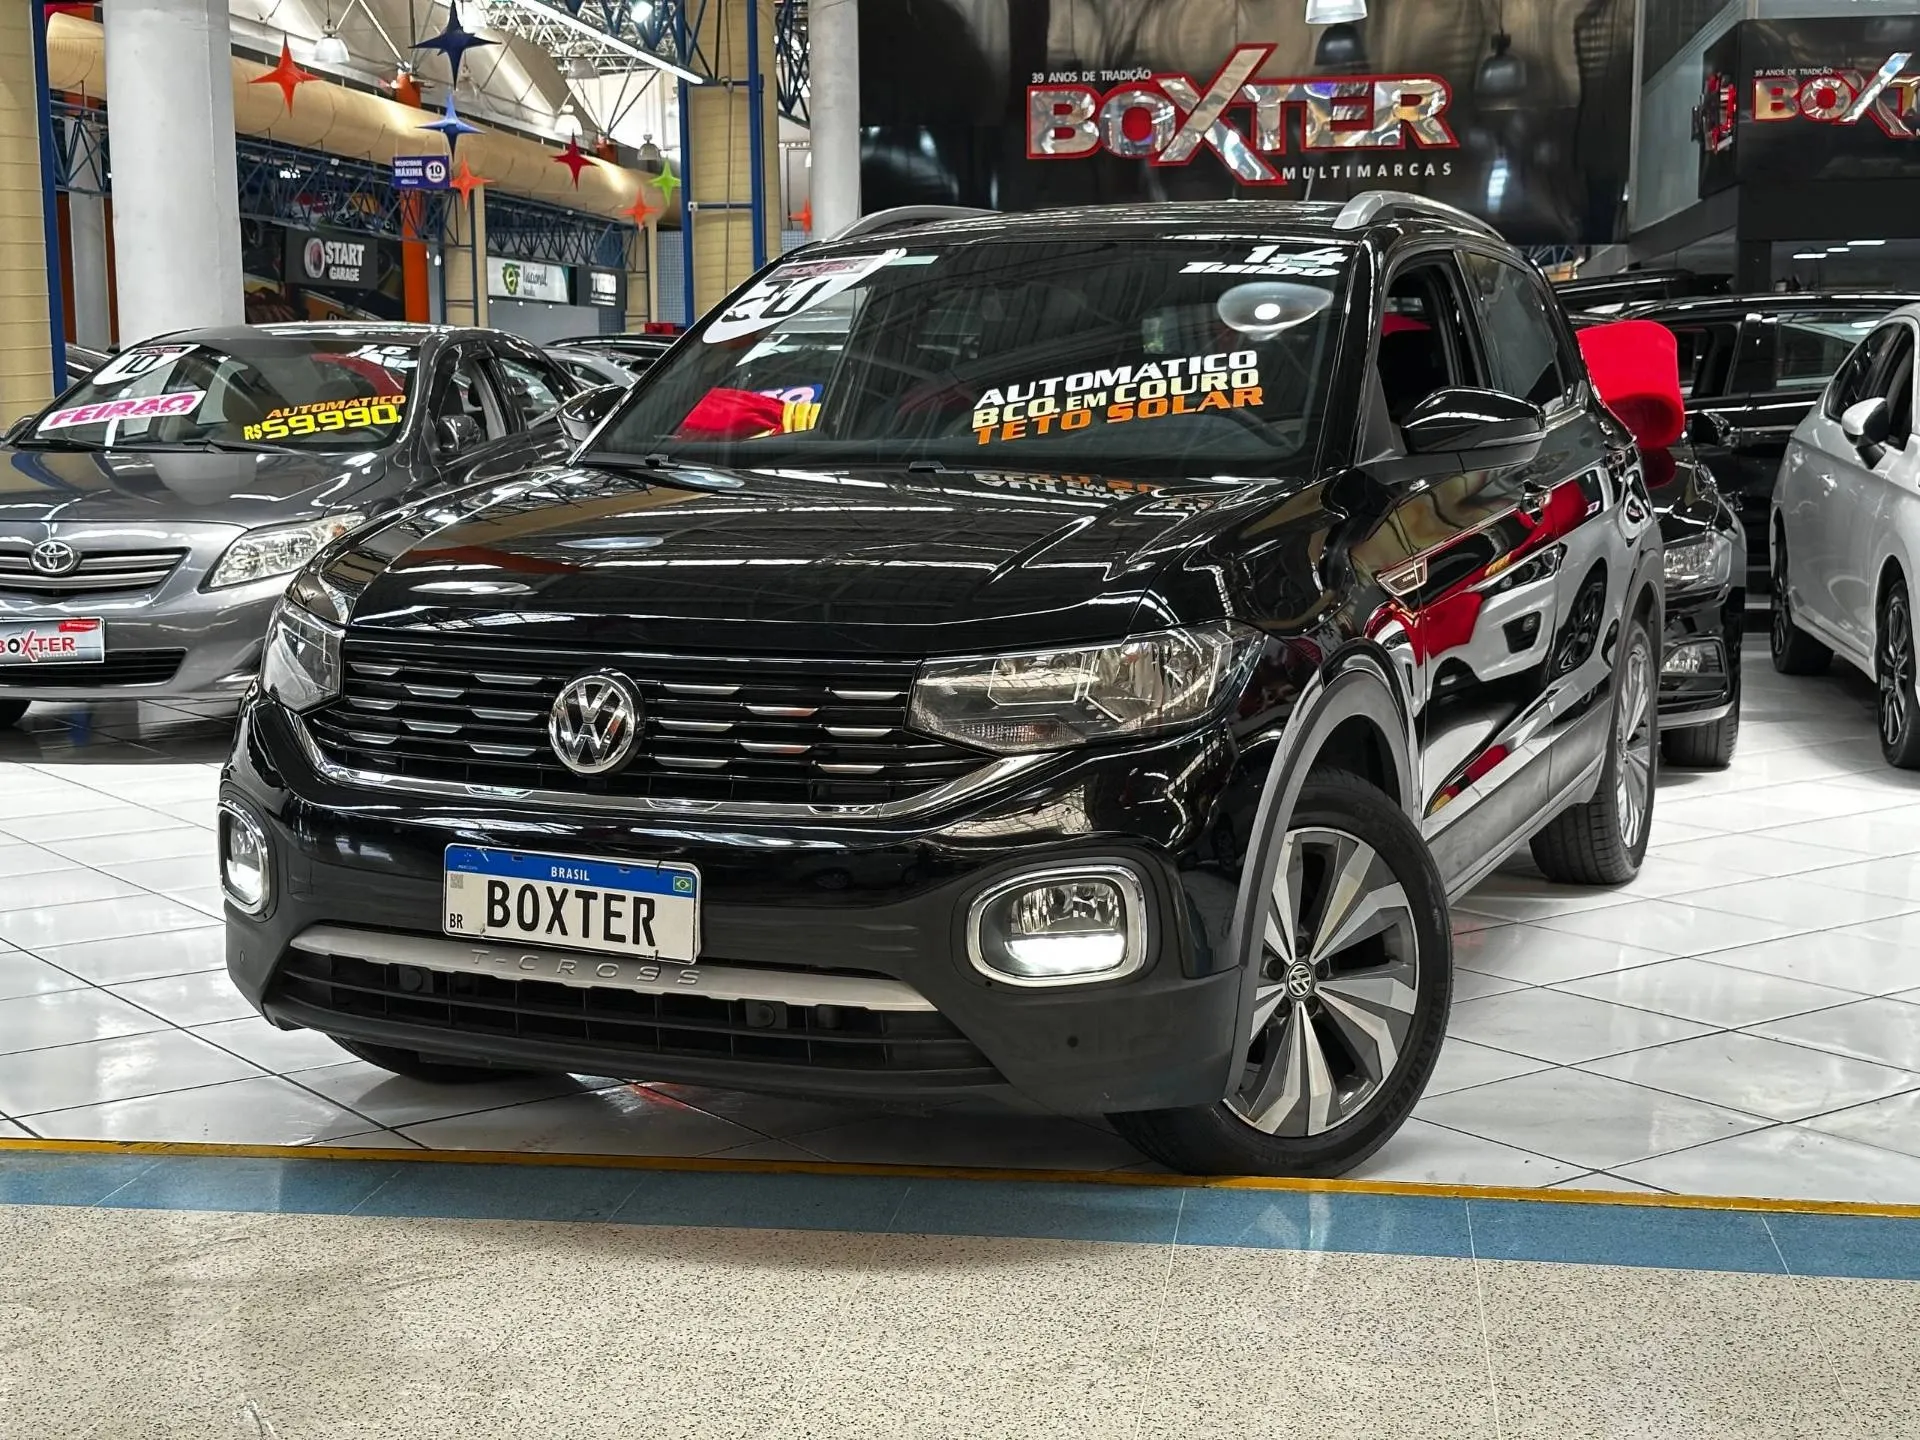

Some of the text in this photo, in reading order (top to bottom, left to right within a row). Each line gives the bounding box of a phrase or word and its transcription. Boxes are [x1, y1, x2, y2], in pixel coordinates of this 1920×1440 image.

[1032, 67, 1152, 83] 39 ANOS DE TRADIÇÃO
[1799, 66, 1833, 76] TRADIÇÃO
[1026, 43, 1460, 186] BOXTER
[429, 165, 442, 175] 10
[1282, 161, 1453, 181] MULTIMARCAS
[325, 241, 364, 266] START
[1244, 245, 1348, 265] 1.4
[329, 267, 360, 281] GARAGE
[1066, 391, 1106, 412] EM
[1113, 368, 1259, 404] COURO
[975, 386, 1264, 445] TETO SOLAR
[551, 866, 590, 881] BRASIL
[449, 913, 463, 929] BR
[486, 879, 656, 947] BOXTER
[471, 949, 700, 985] T-CROSS
